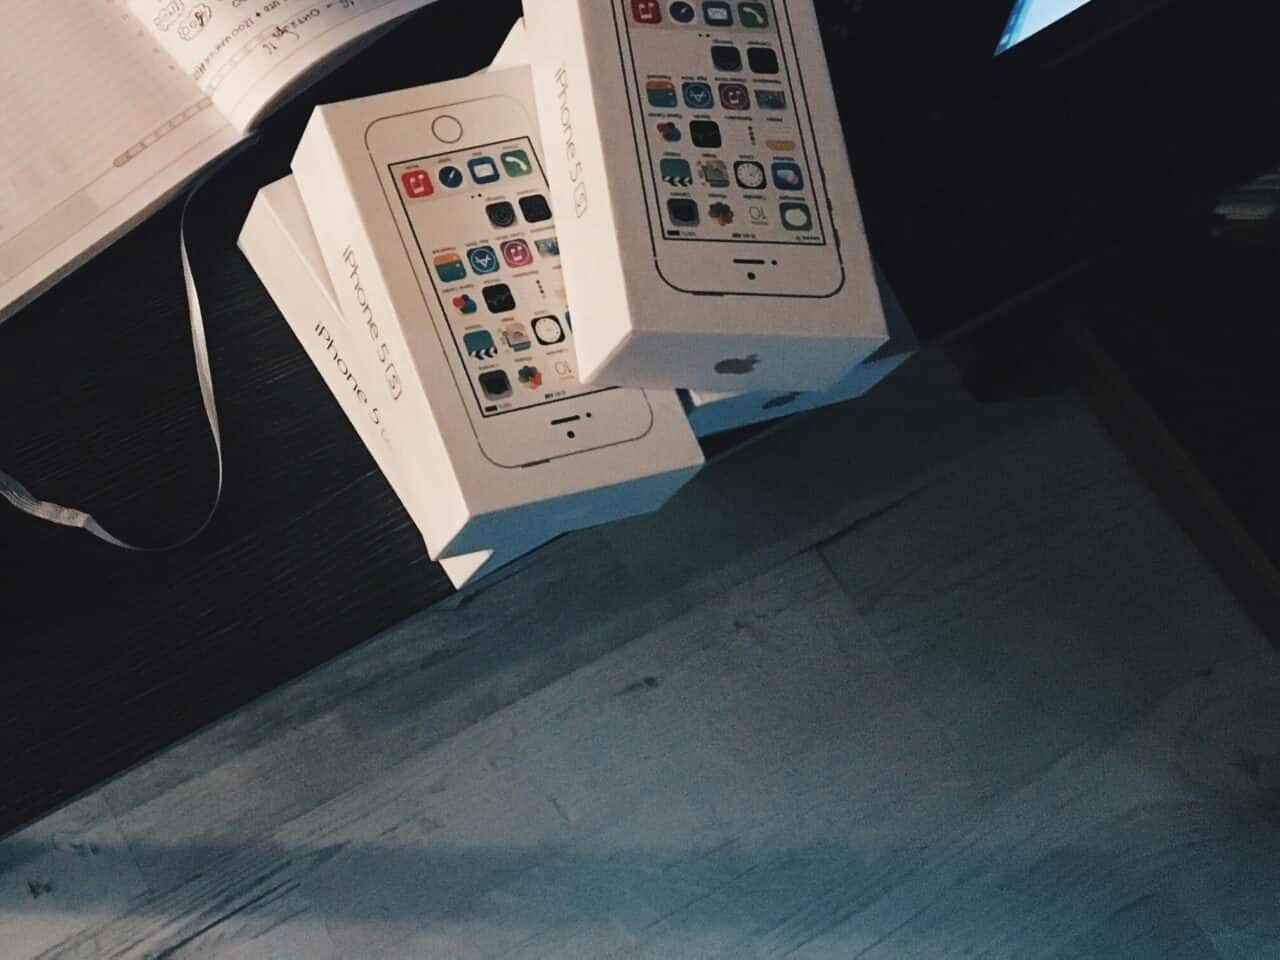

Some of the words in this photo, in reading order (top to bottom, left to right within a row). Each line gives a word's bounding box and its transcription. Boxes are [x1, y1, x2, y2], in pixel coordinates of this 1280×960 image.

[554, 67, 576, 159] iPhone
[342, 245, 379, 340] iPhone
[314, 321, 368, 404] iPhone
